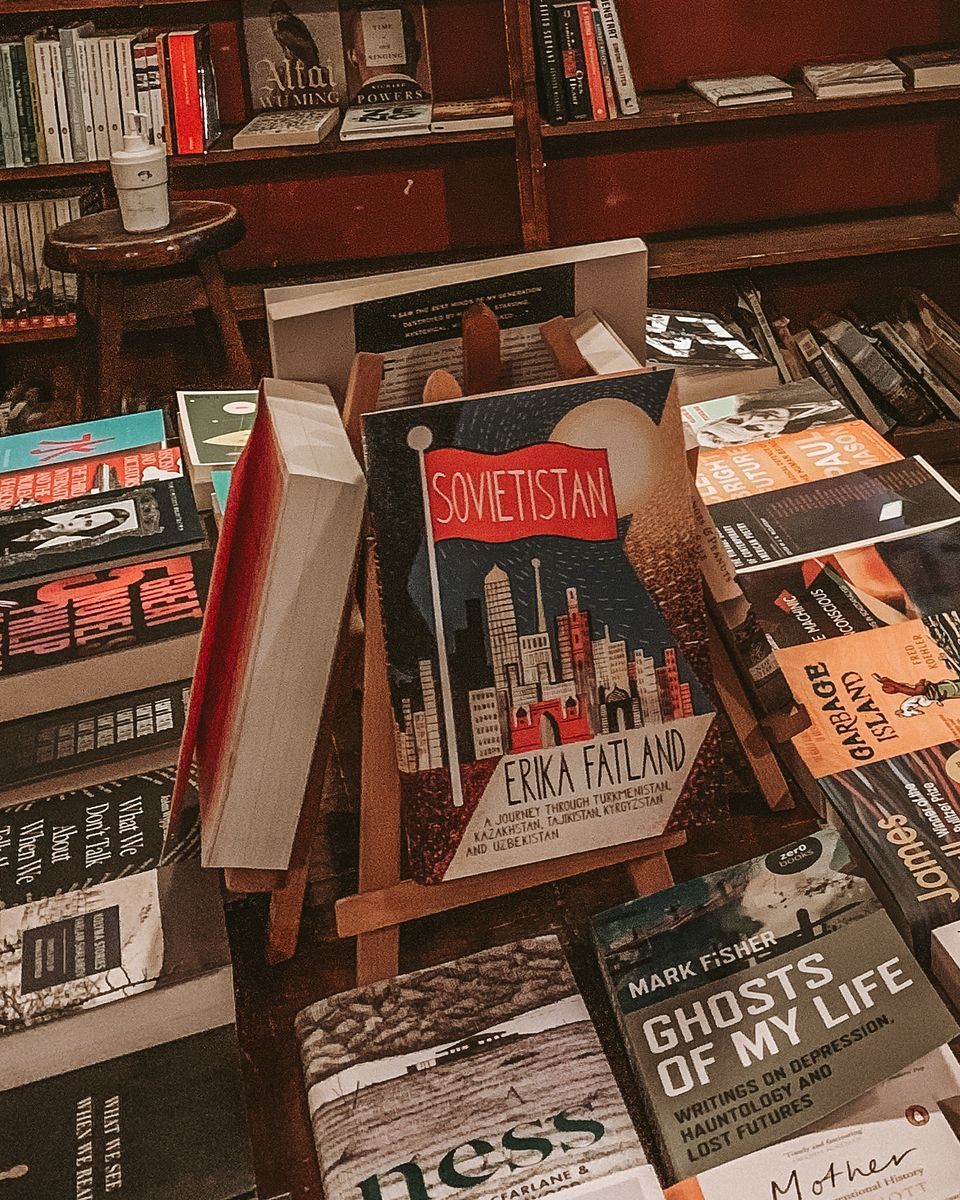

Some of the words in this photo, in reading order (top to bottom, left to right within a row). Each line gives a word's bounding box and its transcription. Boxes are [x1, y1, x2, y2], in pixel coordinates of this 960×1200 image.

[372, 23, 393, 31] TIME
[612, 43, 622, 63] SIMONE
[254, 57, 339, 93] Altai
[297, 90, 340, 106] MING
[357, 89, 424, 104] POWERS
[432, 467, 609, 525] SOVIETISTAN
[140, 573, 202, 626] GREAT
[783, 594, 815, 634] MACHINIC
[903, 645, 922, 665] FRED
[915, 633, 935, 670] KOEHLER
[804, 660, 875, 762] GARBAGE
[840, 670, 900, 743] ISLAND
[504, 752, 576, 807] ERIKA
[582, 728, 686, 790] FATLAND
[84, 802, 110, 837] Don't
[118, 795, 143, 834] What
[474, 822, 544, 842] KAZAKHSTAN,
[603, 796, 664, 816] KYRGYZSTAN
[484, 817, 492, 828] A
[495, 807, 541, 826] JOURNEY
[545, 797, 590, 817] THROUGH
[592, 780, 672, 806] TURKMENISTAN,
[18, 819, 44, 861] When
[51, 825, 78, 865] About
[84, 837, 108, 869] Talk
[118, 832, 144, 857] We
[465, 845, 488, 857] AND
[493, 830, 560, 852] UZBEKISTAN
[778, 842, 808, 862] zero
[778, 847, 815, 868] books
[15, 859, 42, 886] We
[628, 960, 698, 1000] MARK
[641, 952, 834, 1055] GHOSTS
[656, 1040, 717, 1098] OF
[731, 1006, 801, 1068] MY
[812, 955, 914, 1030] LIFE
[674, 1079, 759, 1126] WRITINGS
[762, 1067, 786, 1087] ON
[790, 1013, 895, 1078] DEPRESSION,
[75, 1096, 92, 1140] WHEN
[103, 1096, 120, 1135] WHAT
[680, 1086, 793, 1144] HAUNTOLOGY
[799, 1063, 833, 1092] AND
[685, 1131, 732, 1163] LOST
[737, 1094, 815, 1140] FUTURES
[76, 1142, 93, 1167] WE
[104, 1138, 122, 1163] WE
[355, 1102, 606, 1200] ness
[104, 1166, 122, 1193] SEE
[770, 1147, 917, 1200] Mother
[884, 1167, 924, 1188] History
